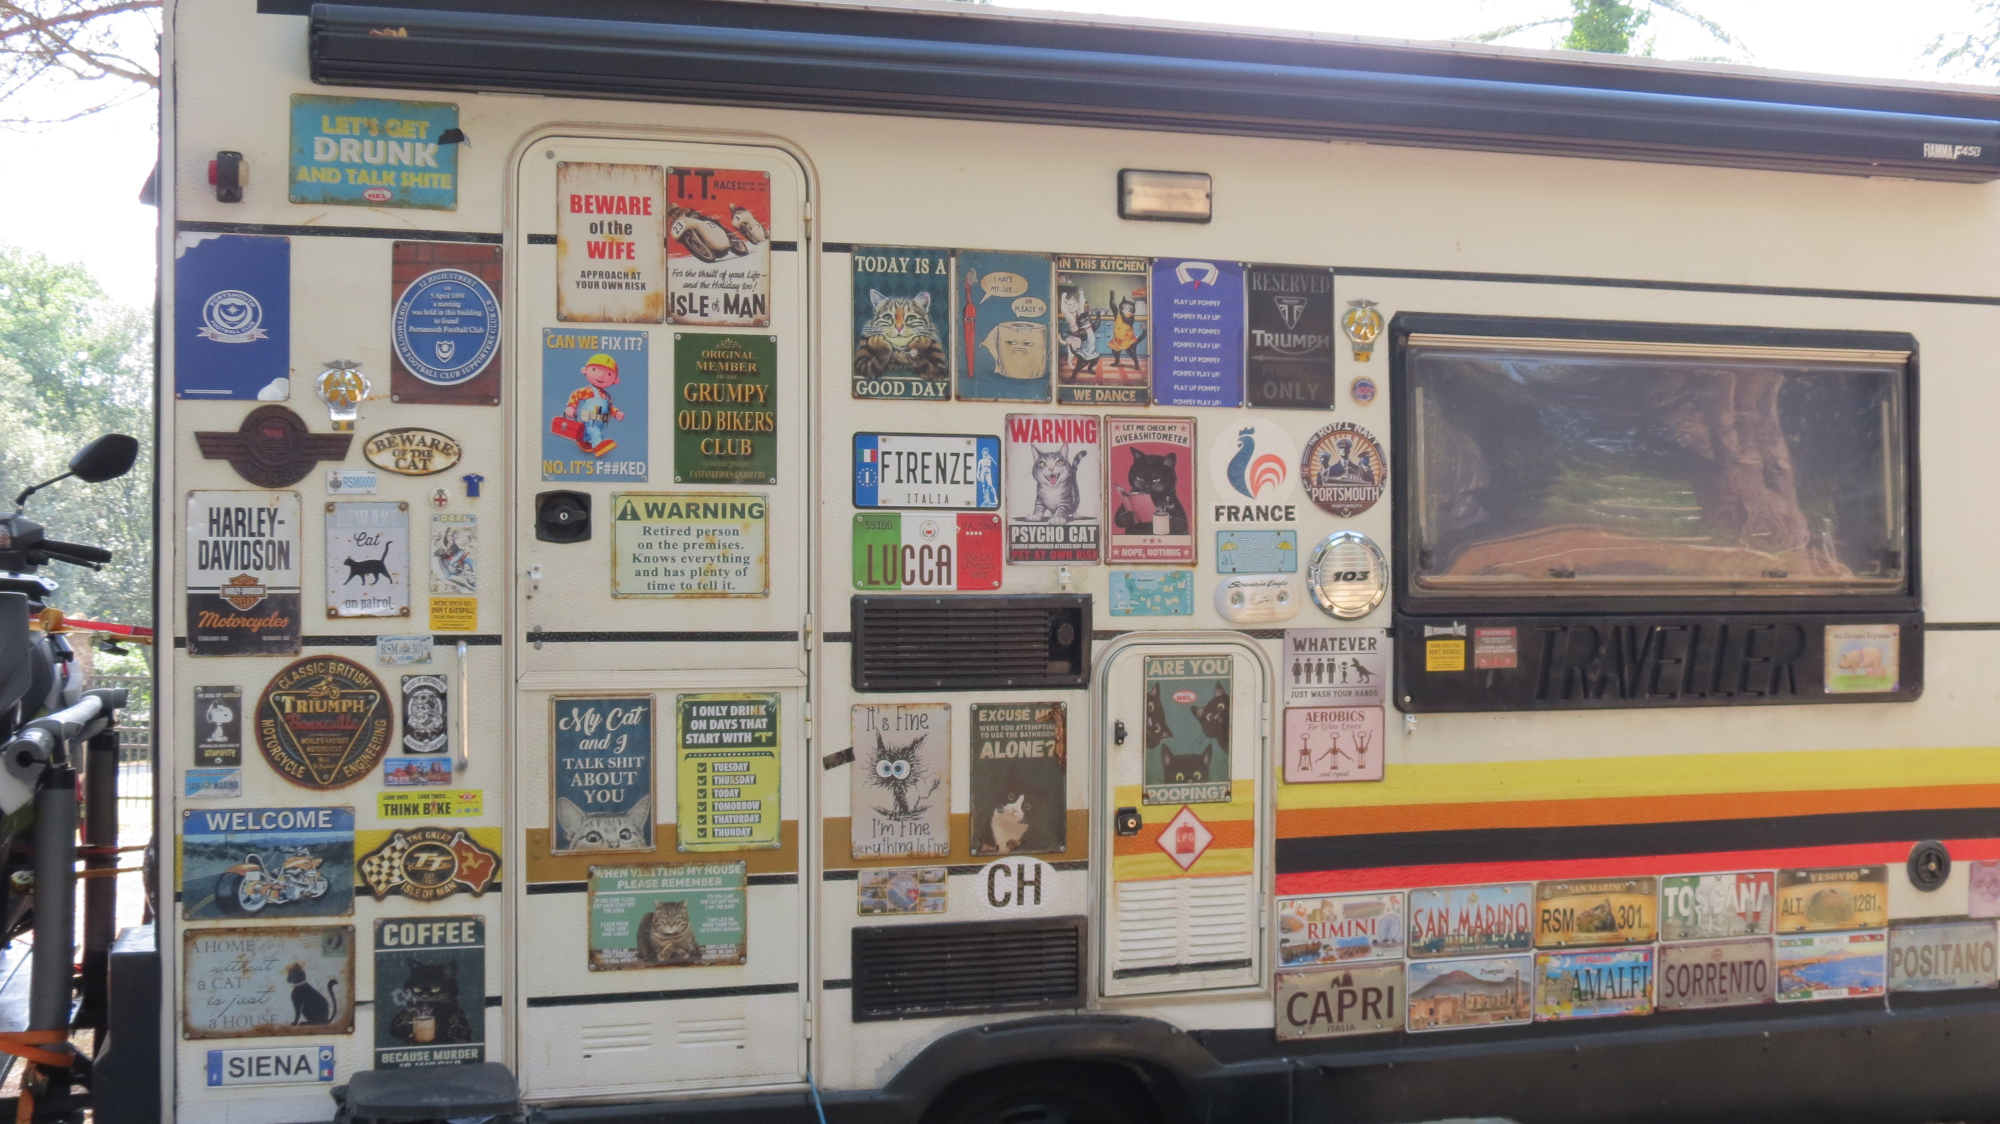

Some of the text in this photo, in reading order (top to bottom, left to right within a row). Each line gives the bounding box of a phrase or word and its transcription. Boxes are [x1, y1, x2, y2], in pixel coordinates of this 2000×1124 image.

[322, 115, 430, 139] LET'S GET
[313, 136, 438, 167] DRUNK
[296, 166, 452, 190] AND TALK SHITE
[570, 194, 652, 216] BEWARE
[587, 240, 635, 260] WIFE
[854, 256, 947, 275] TODAY IS A
[1060, 259, 1145, 272] IN THIS KITCHEN
[580, 269, 642, 281] APPROACH AT
[1252, 271, 1330, 294] RESERVED
[576, 279, 647, 291] YOUR OWN RISK
[210, 292, 256, 307] PORTSMOUTH
[1189, 299, 1197, 307] UP
[547, 335, 643, 351] CAN WE FIX IT?
[1252, 329, 1330, 349] TRIUMPH
[702, 350, 755, 360] ORIGINAL
[696, 361, 757, 372] MEMBER
[684, 382, 768, 404] GRUMPY
[856, 381, 948, 397] GOOD DAY
[1073, 389, 1136, 401] WE DANCE
[1263, 381, 1319, 401] ONLY
[679, 409, 774, 432] OLD BIKERS
[1008, 418, 1098, 445] WARNING
[1115, 432, 1188, 445] GIVEASHITOMETER
[372, 435, 455, 456] BEWARE
[392, 449, 434, 458] OF THE
[700, 438, 752, 455] CLUB
[395, 458, 431, 471] CAT
[543, 460, 646, 476] NO. IT'S F##KED
[881, 451, 975, 485] FIRENZE
[907, 493, 950, 505] ITALIA
[1312, 486, 1380, 502] PORTSMOUTH
[644, 502, 765, 520] WARNING
[1214, 505, 1296, 522] FRANCE
[208, 507, 285, 538] HARLEY-
[354, 532, 381, 547] Cat
[642, 526, 739, 539] Retired person
[1011, 526, 1097, 543] PSYCHO CAT
[637, 540, 744, 553] on the premises.
[1239, 538, 1276, 551] TAN
[198, 540, 290, 571] DAVIDSON
[632, 552, 751, 566] Knows everything
[964, 552, 994, 563] The City
[1121, 548, 1181, 559] NOPE, NOTHING
[867, 544, 952, 586] LUCCA
[635, 567, 748, 580] and has plenty of
[970, 571, 989, 579] walls
[1333, 571, 1370, 582] 103
[345, 597, 392, 611] on patrol
[198, 611, 290, 633] Motorcycles
[1293, 637, 1378, 652] WHATEVER
[1148, 660, 1229, 675] ARE YOU
[1534, 624, 1807, 699] TRAVELLER
[279, 662, 372, 690] CLASSIC BRITISH
[1291, 689, 1378, 698] JUST WASH YOUR HANDS
[281, 696, 366, 713] TRIUMPH
[692, 704, 767, 717] I ONLY DRINK
[559, 705, 649, 736] My Cat
[690, 718, 768, 730] ON DAYS THAT
[866, 705, 930, 732] It's Fine
[1305, 710, 1366, 723] AEROBICS
[980, 741, 1056, 760] ALONE?
[563, 756, 645, 770] TALK SHIT
[713, 762, 748, 772] TUESDAY
[570, 772, 638, 787] ABOUT
[713, 775, 755, 785] THURSDAY
[583, 788, 626, 804] YOU
[713, 788, 739, 798] TODAY
[1147, 785, 1227, 801] POOPING?
[713, 801, 760, 811] TOMORROW
[206, 810, 333, 831] WELCOME
[713, 814, 760, 824] THATURDAY
[872, 816, 930, 838] I'm Fine
[406, 831, 452, 844] THE GREAT
[713, 827, 751, 837] THUNDAY
[1177, 833, 1194, 842] LPG
[617, 877, 722, 890] PLEASE REMEMBER
[1810, 871, 1859, 882] VESUVIO
[987, 863, 1042, 907] CH
[1569, 882, 1626, 896] SAN MARINO
[1782, 894, 1877, 917] ALT. 1281
[1413, 902, 1529, 939] SAN MARINO
[1541, 903, 1643, 934] RSM 301
[383, 921, 476, 946] COFFEE
[1307, 919, 1376, 940] RIMINI
[191, 940, 255, 953] A HOME
[1890, 941, 1995, 978] POSITANO
[1571, 965, 1650, 1002] AMALFI
[1664, 958, 1767, 998] SORRENTO
[1286, 985, 1395, 1027] CAPRI
[1327, 1023, 1356, 1033] ITALIA
[381, 1048, 479, 1064] BECAUSE MURDER
[228, 1054, 313, 1078] SIENA
